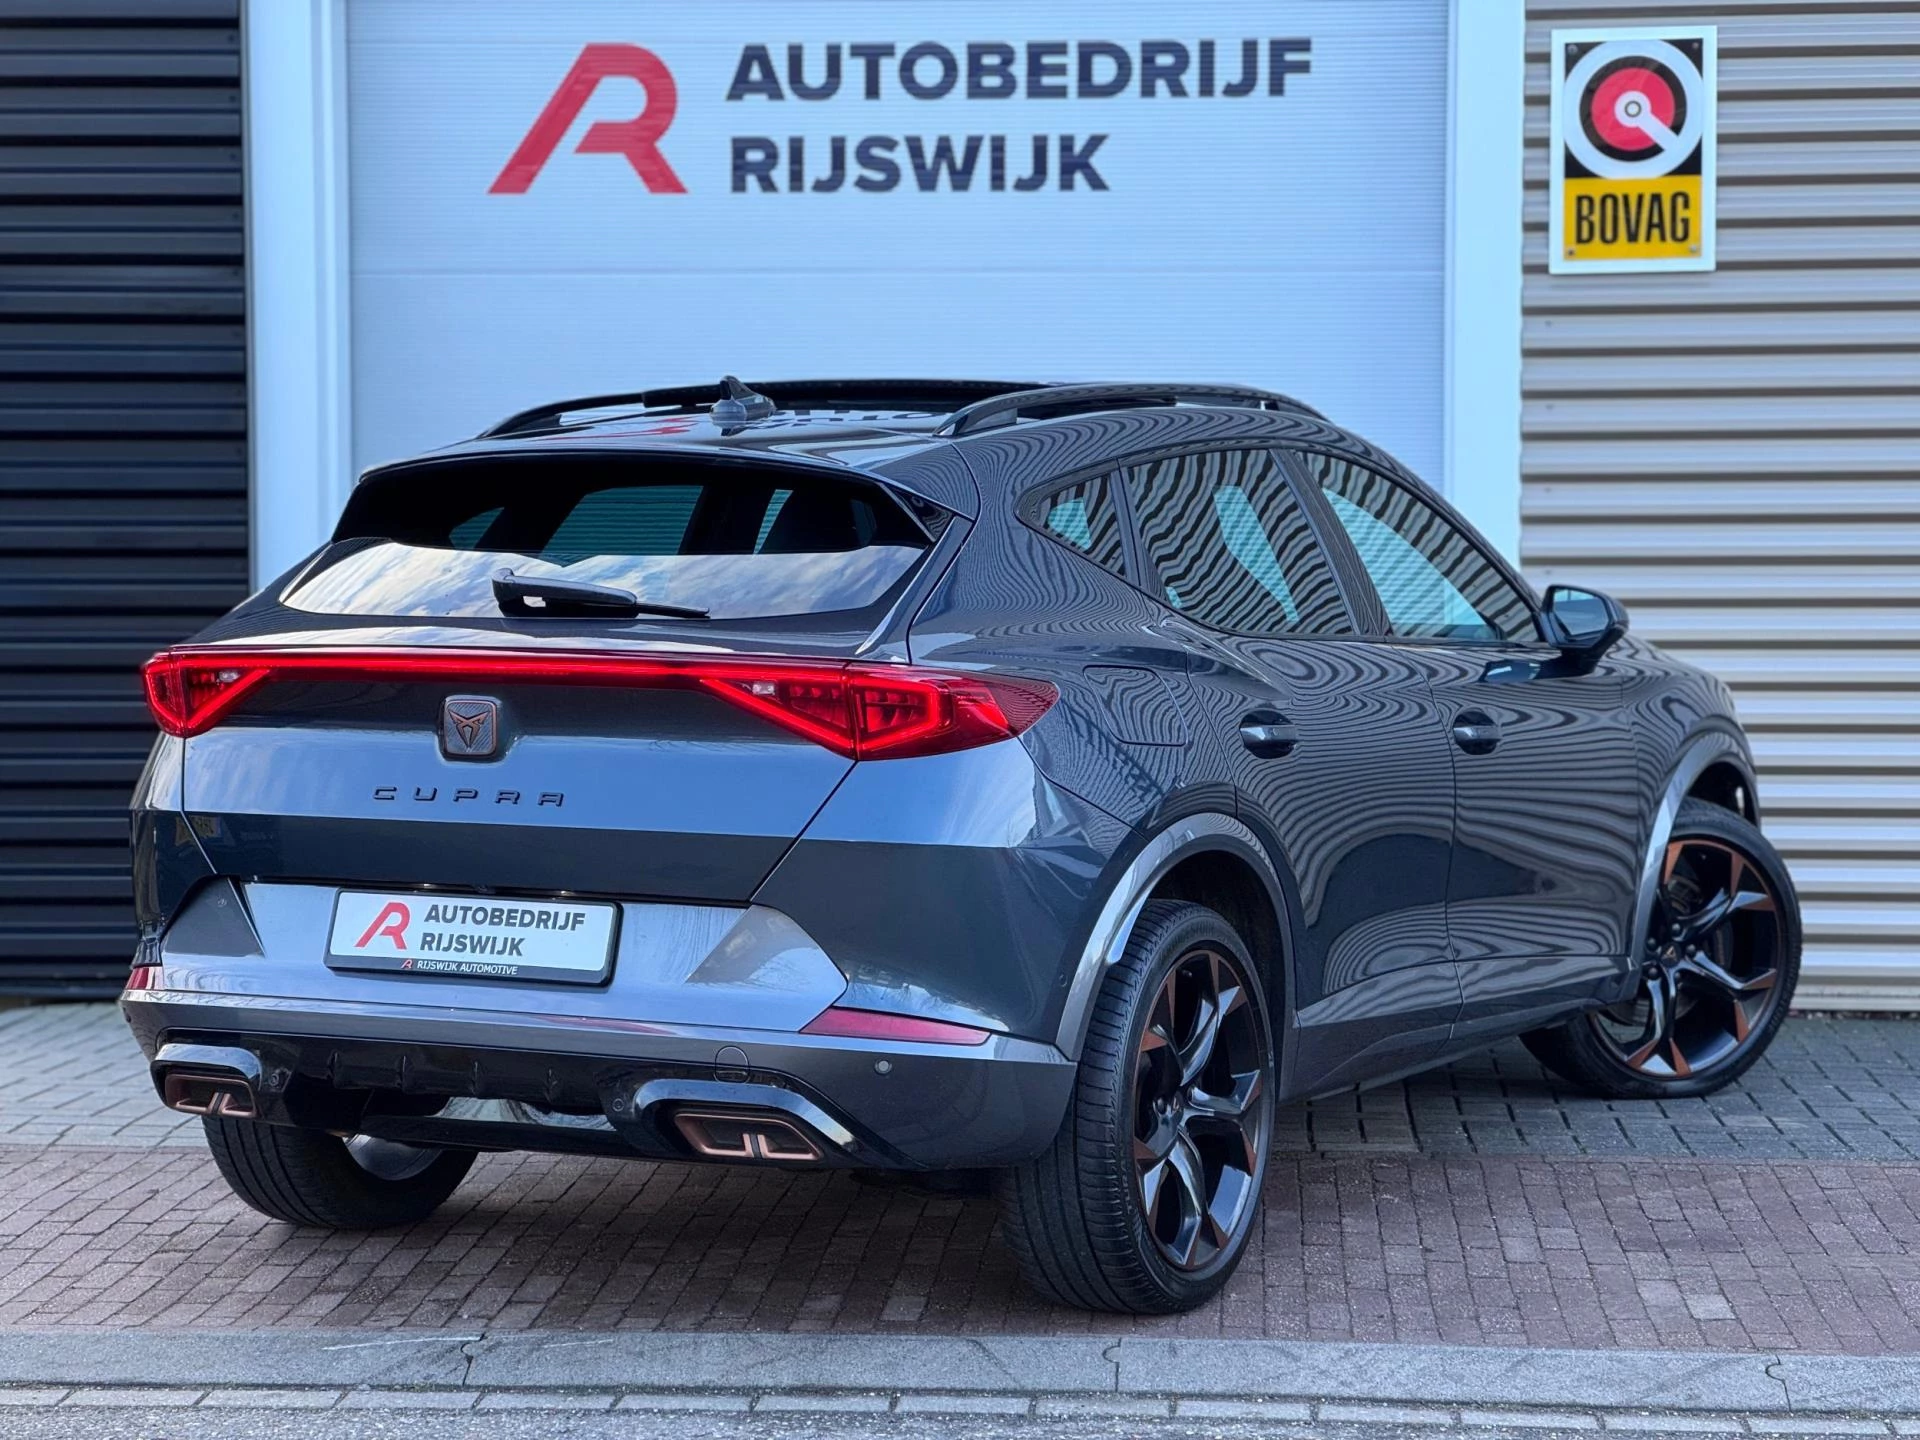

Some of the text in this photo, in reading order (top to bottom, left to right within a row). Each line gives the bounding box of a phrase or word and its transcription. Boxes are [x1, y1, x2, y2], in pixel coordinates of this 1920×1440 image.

[726, 37, 1312, 102] AUTOBEDRIJF
[730, 133, 1111, 194] RIJSWIJK
[1575, 191, 1690, 245] BOVAG
[373, 786, 565, 807] CUPRA
[424, 903, 586, 931] AUTOBEDRIJF
[420, 932, 525, 957] RIJSWIJK
[417, 960, 518, 975] RIJSWIJK AUTOMOTIVE
